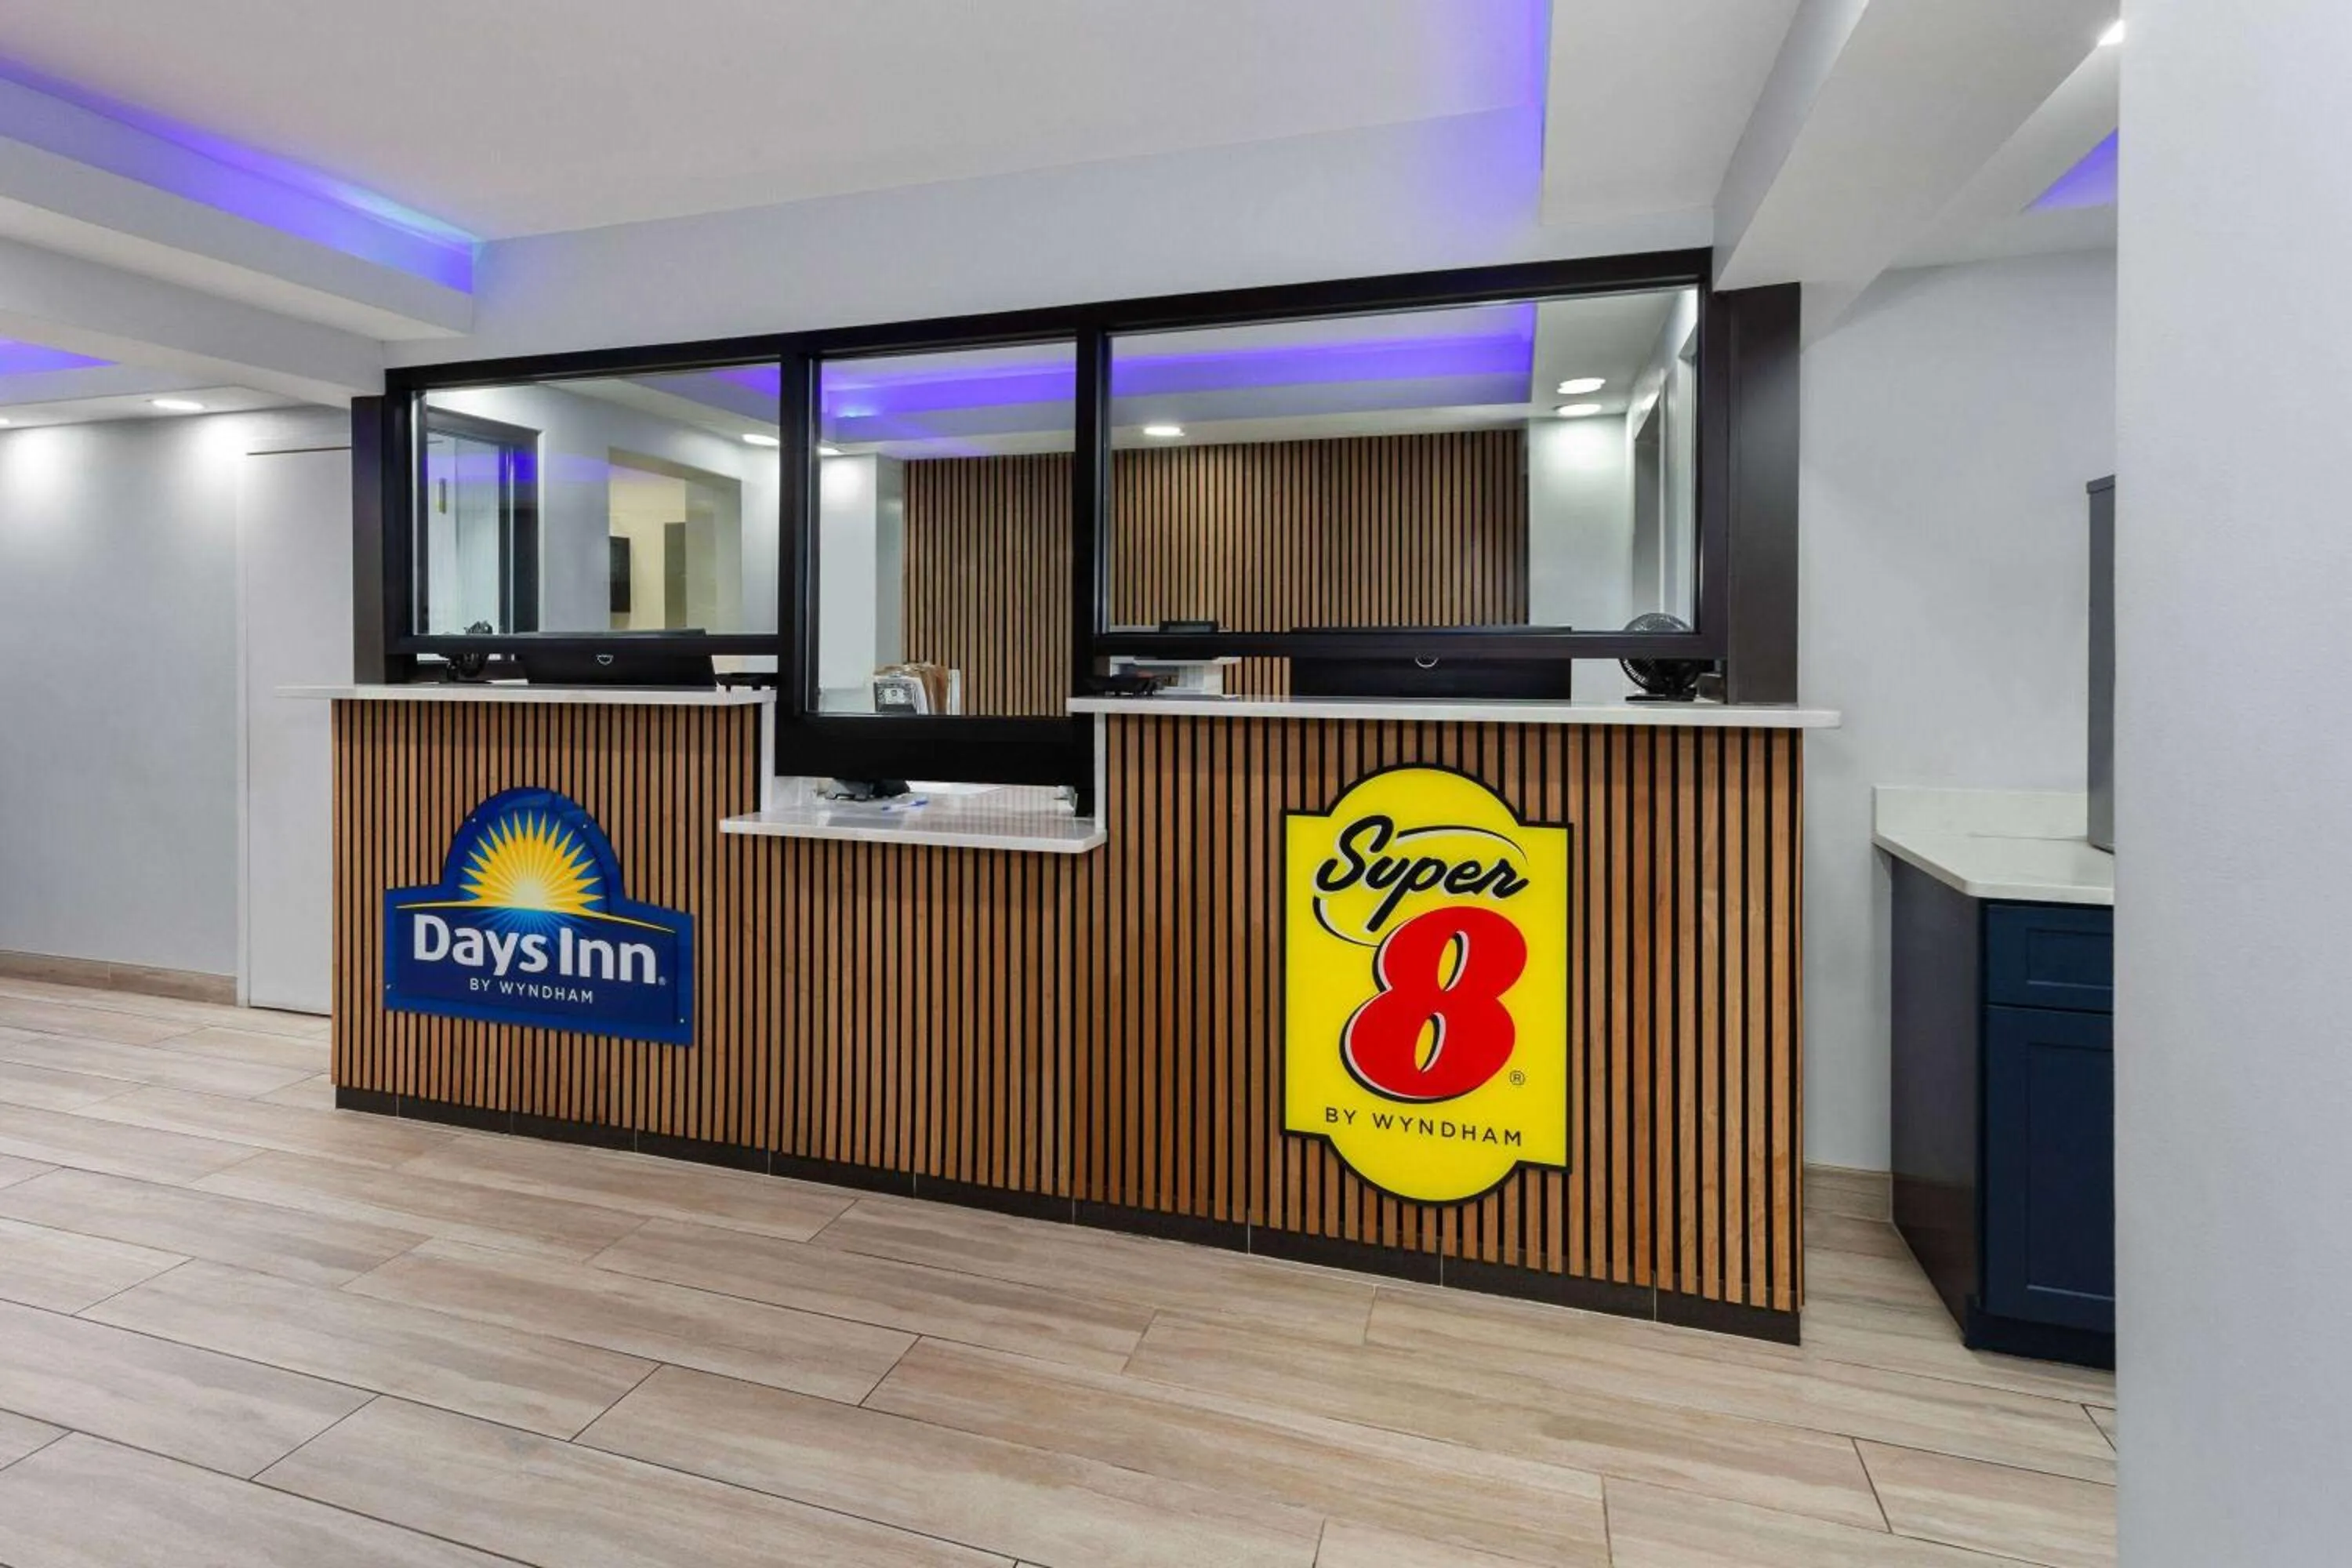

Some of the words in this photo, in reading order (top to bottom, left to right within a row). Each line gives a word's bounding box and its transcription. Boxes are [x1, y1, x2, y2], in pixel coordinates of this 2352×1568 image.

[1316, 814, 1530, 933] Super
[413, 913, 549, 976] Days
[560, 927, 657, 984] Inn
[470, 978, 490, 992] BY
[500, 982, 593, 1004] WYNDHAM
[1340, 906, 1527, 1105] 8
[1325, 1107, 1357, 1124] BY
[1373, 1113, 1522, 1147] WYNDHAM
